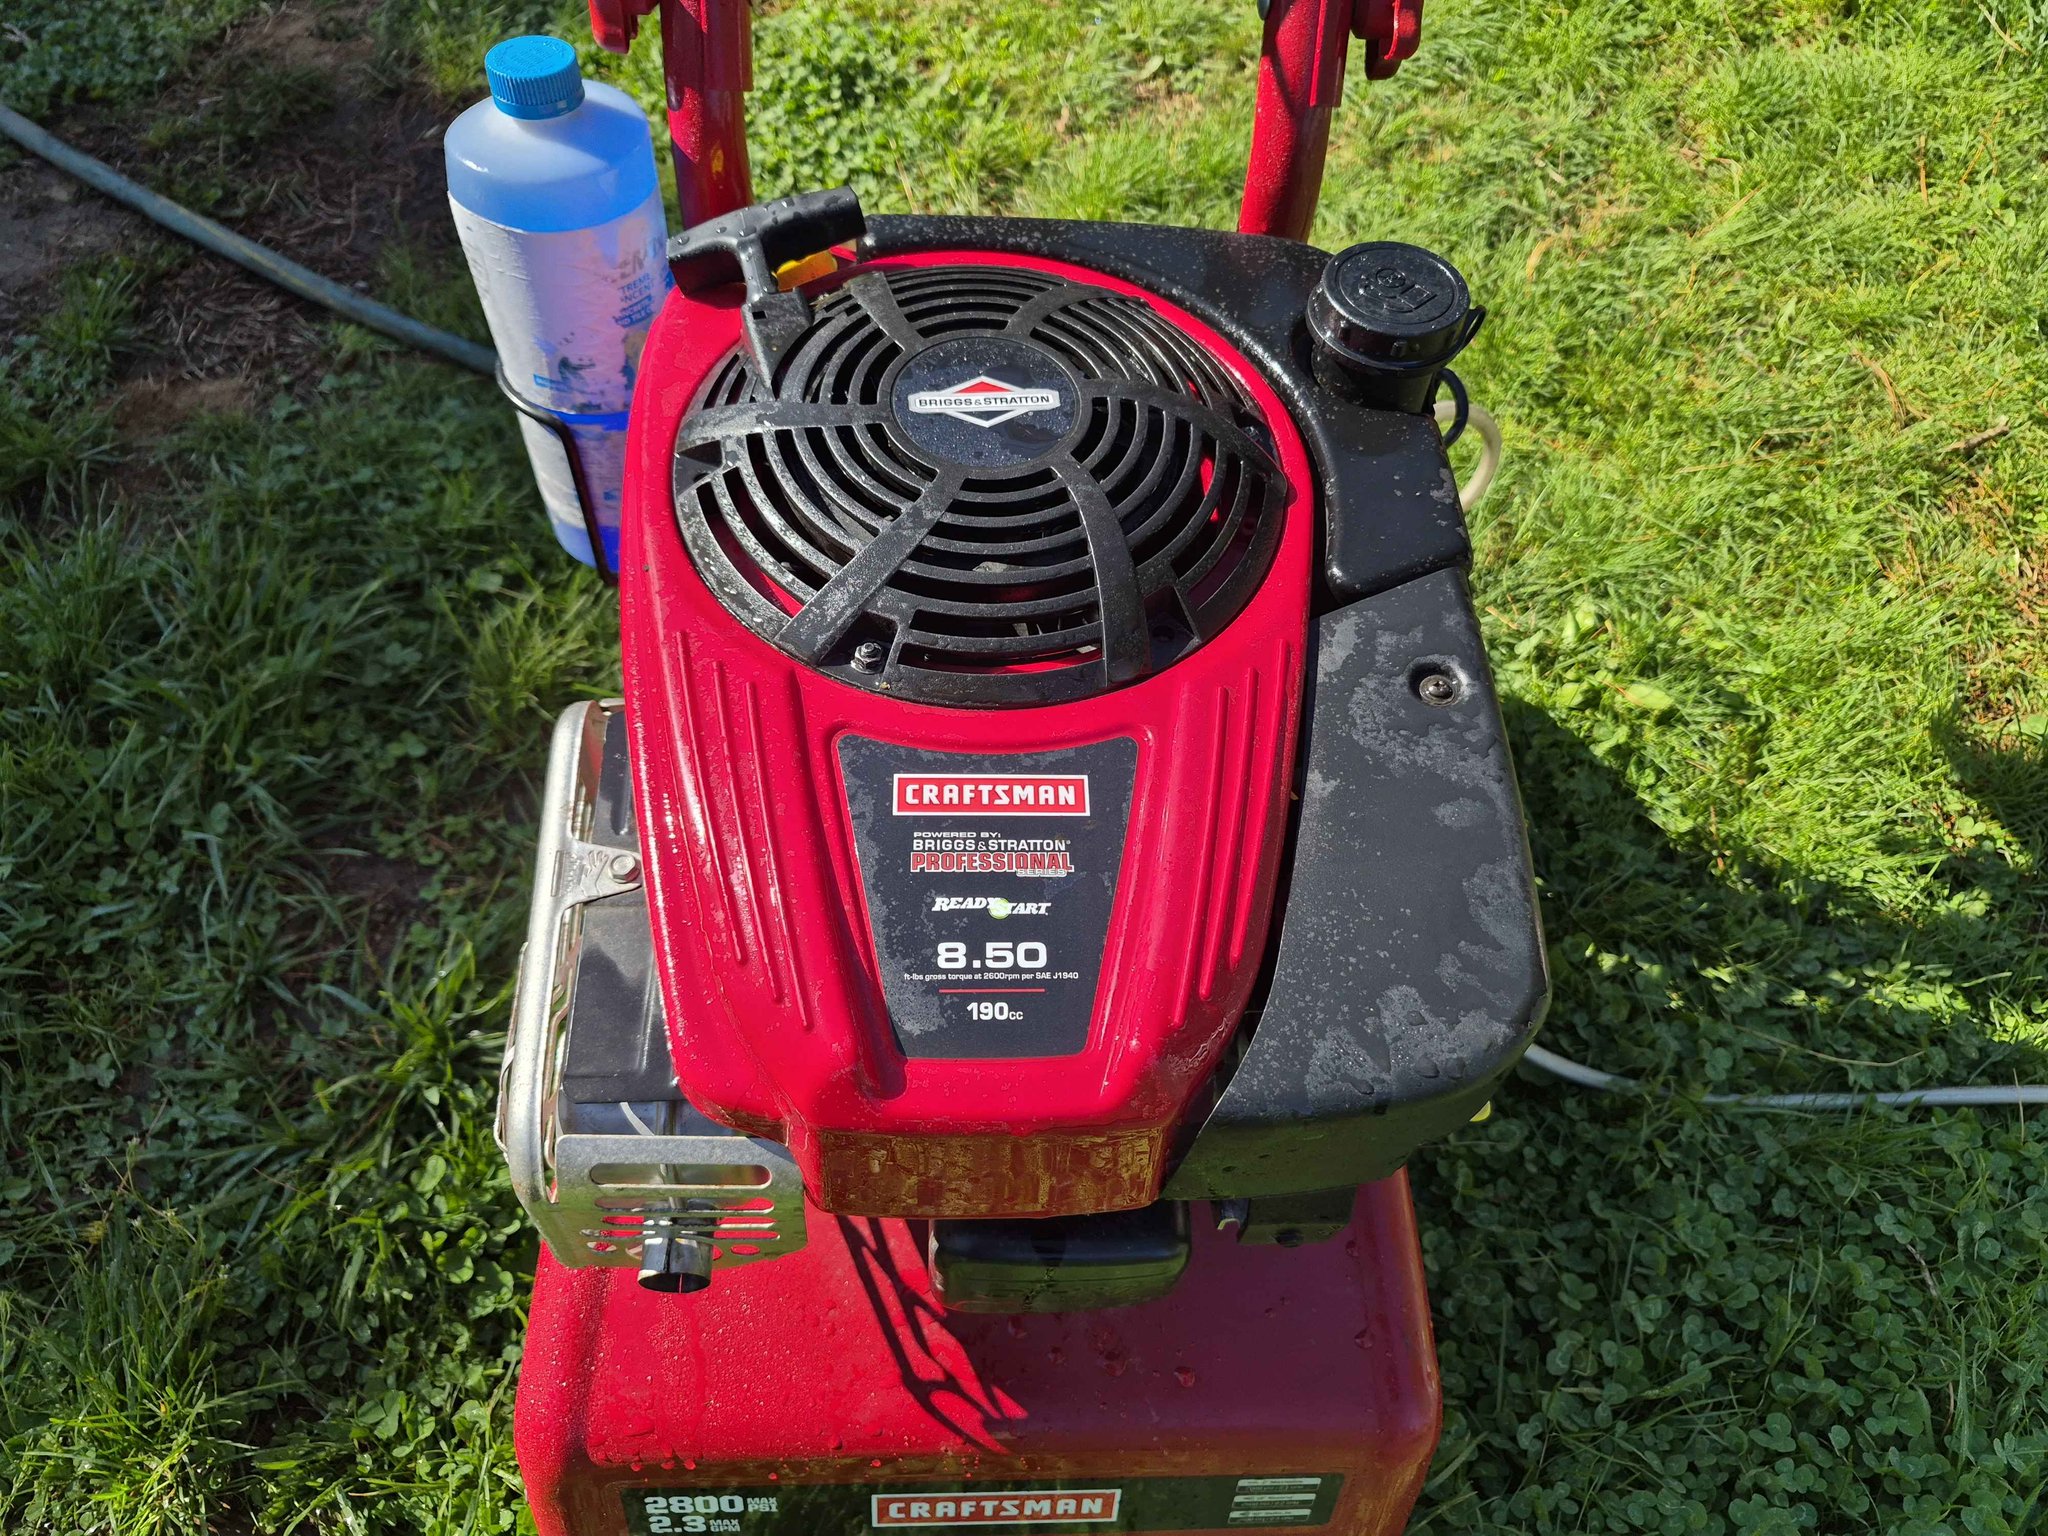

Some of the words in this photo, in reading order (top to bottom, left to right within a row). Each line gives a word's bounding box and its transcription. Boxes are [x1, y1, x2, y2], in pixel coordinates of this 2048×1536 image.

[905, 784, 1076, 805] CRAFTSMAN
[911, 852, 1074, 873] PROFESSIONAL
[1016, 868, 1067, 877] SERIES
[937, 942, 1047, 968] 8.50
[904, 973, 924, 981] ft-lbs
[925, 974, 947, 982] gross
[948, 973, 973, 982] torque
[973, 973, 982, 981] at
[983, 972, 1020, 982] 2600rpm
[1021, 974, 1034, 982] per
[1035, 972, 1051, 980] SAE
[1052, 972, 1079, 980] J1940
[644, 1495, 745, 1514] 2800
[747, 1497, 778, 1505] MAX
[747, 1504, 778, 1512] PSI
[888, 1498, 1103, 1518] CRAFTSMAN
[648, 1515, 707, 1533] 2.3
